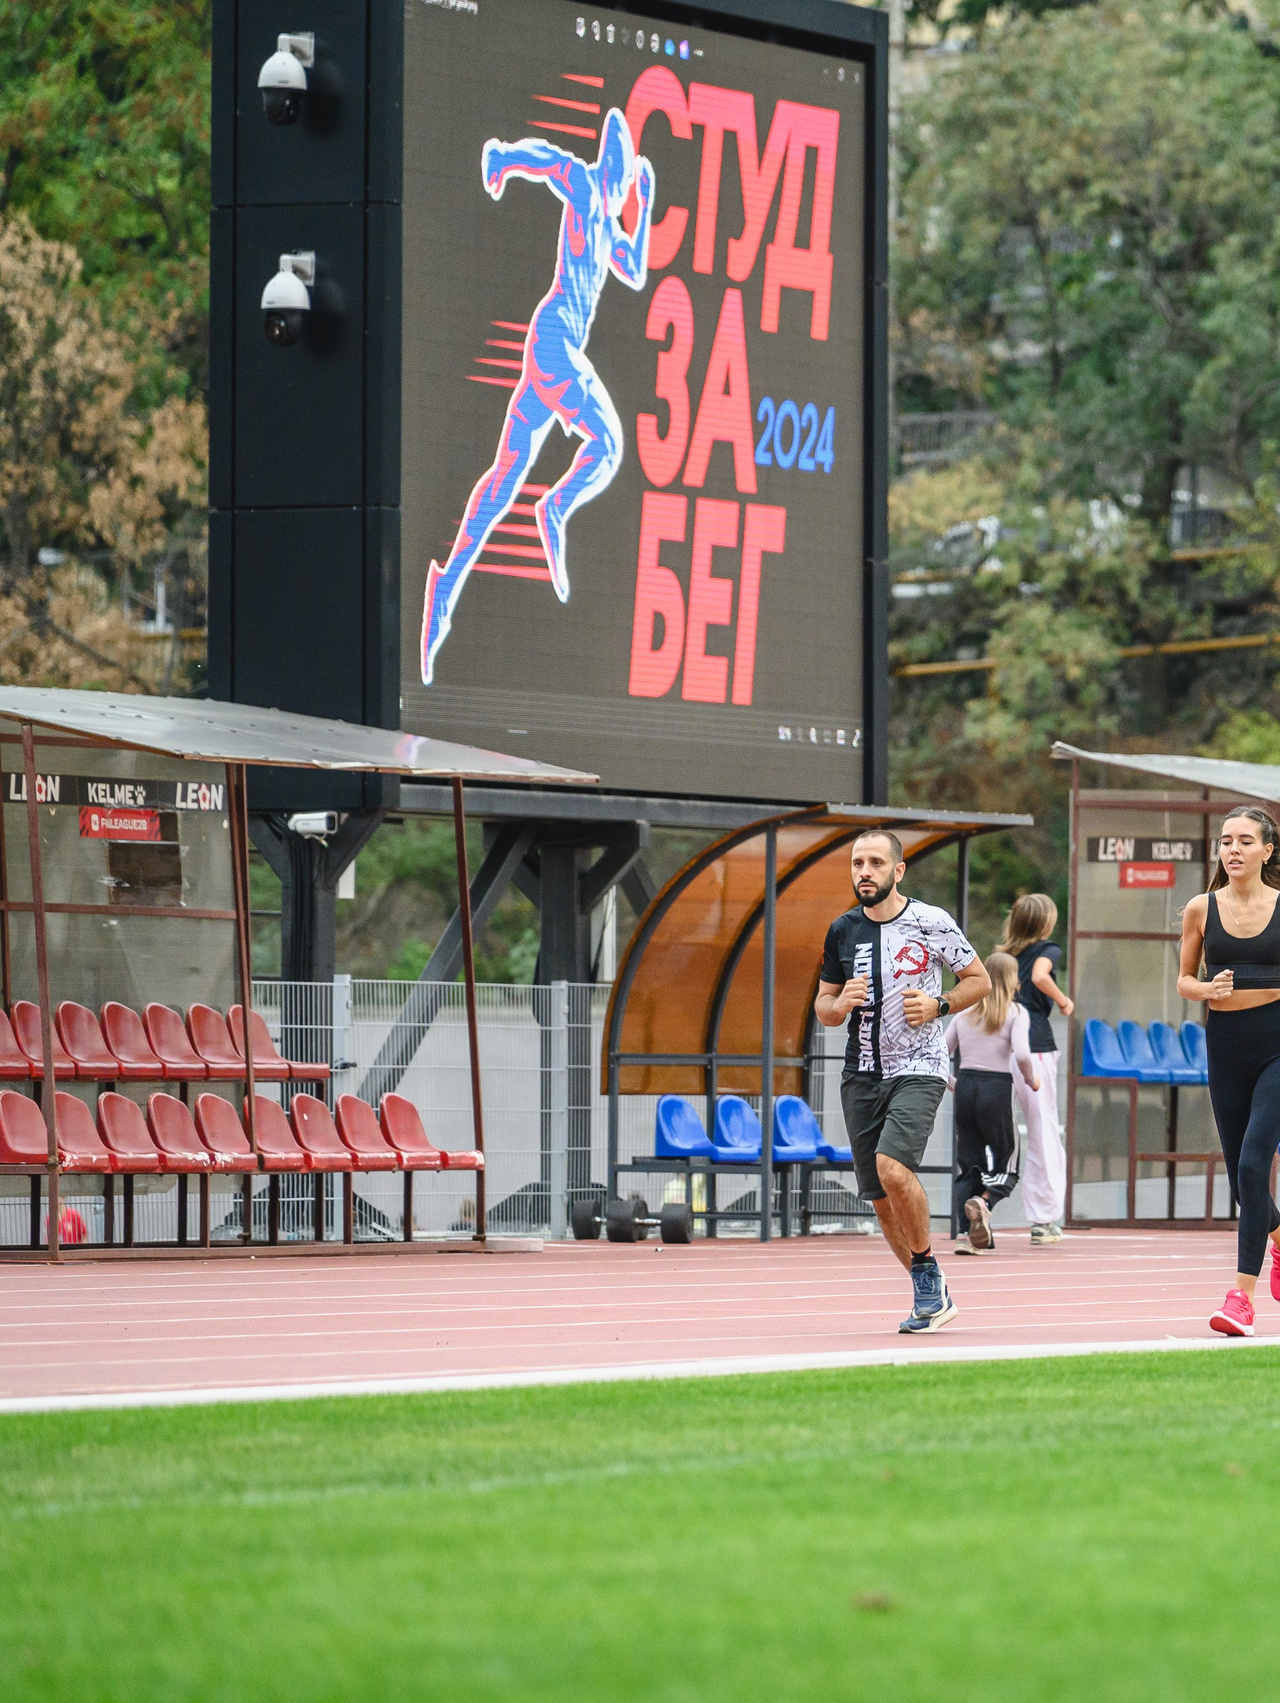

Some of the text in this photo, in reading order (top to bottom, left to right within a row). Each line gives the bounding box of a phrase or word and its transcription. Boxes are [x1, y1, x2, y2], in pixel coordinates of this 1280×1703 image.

[622, 65, 840, 341] СТУД
[637, 275, 757, 494] ЗА
[755, 396, 835, 473] 2024
[628, 491, 787, 706] БЕГ
[87, 782, 134, 804] KELME
[175, 782, 223, 811] LEON
[1098, 837, 1135, 862] LEON
